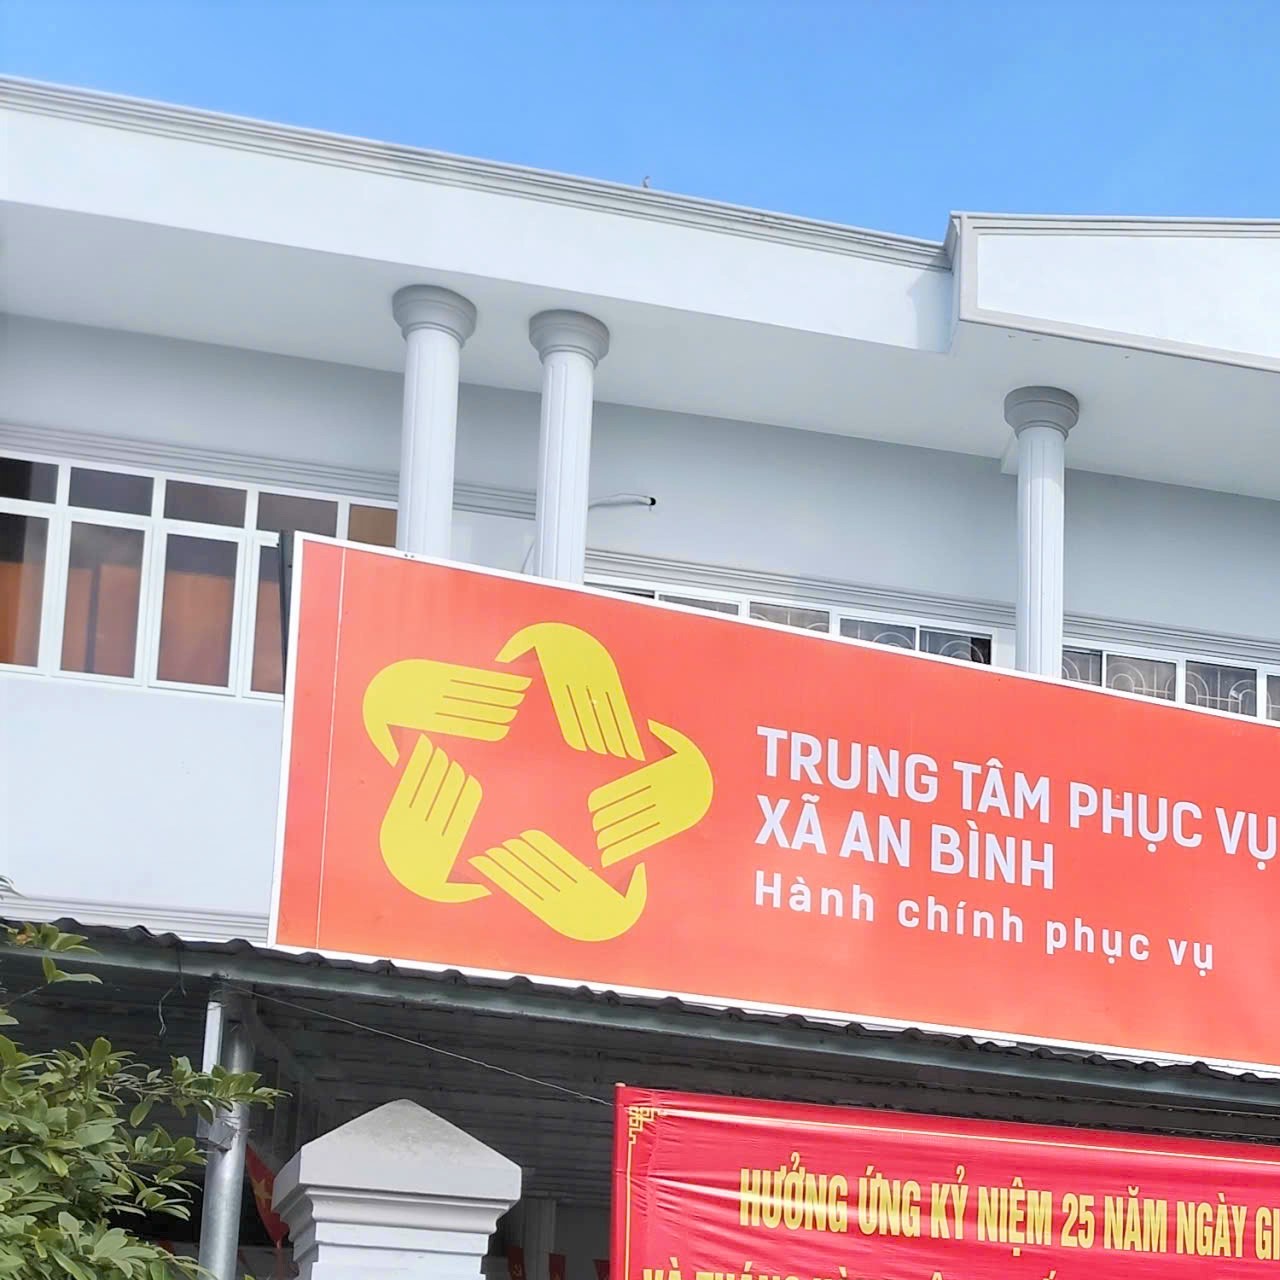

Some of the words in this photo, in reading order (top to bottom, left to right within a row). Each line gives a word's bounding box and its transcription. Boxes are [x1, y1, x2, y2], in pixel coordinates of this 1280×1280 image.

[755, 793, 827, 855] XÃ
[839, 810, 911, 868] AN
[930, 821, 1054, 890] BÌNH
[757, 726, 938, 803] TRUNG
[953, 758, 1049, 823] TÂM
[1069, 782, 1202, 852] PHỤC
[1215, 808, 1278, 871] VỤ
[754, 869, 875, 923] Hành
[898, 896, 1024, 943] chính
[1046, 918, 1151, 964] phục
[1168, 937, 1214, 977] vụ
[739, 1152, 848, 1234] HƯỞNG
[858, 1165, 921, 1238] ỨNG
[930, 1165, 969, 1240] KỶ
[977, 1177, 1052, 1257] NIỆM
[1062, 1194, 1095, 1249] 25
[1104, 1186, 1168, 1254] NĂM
[1176, 1192, 1248, 1258] NGÀY
